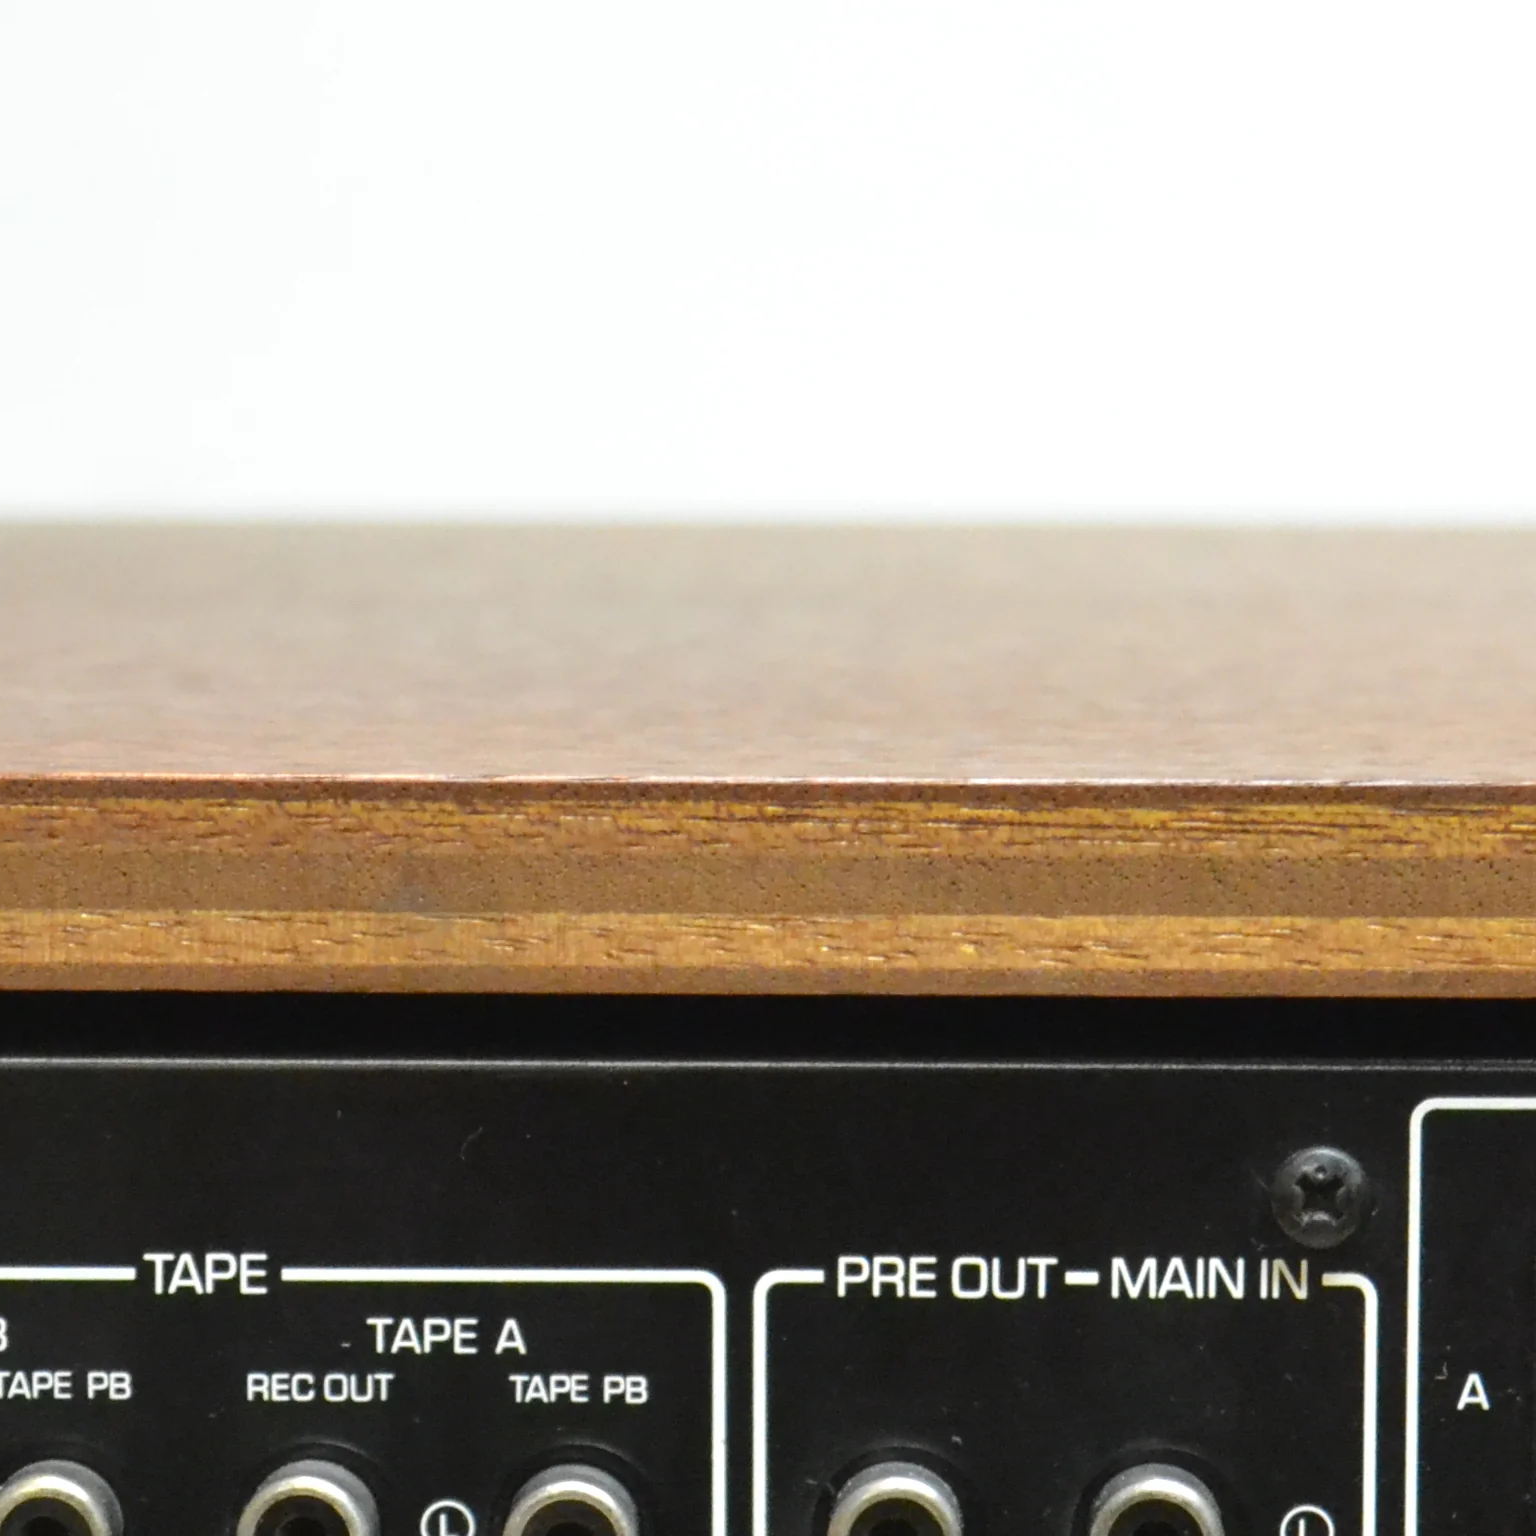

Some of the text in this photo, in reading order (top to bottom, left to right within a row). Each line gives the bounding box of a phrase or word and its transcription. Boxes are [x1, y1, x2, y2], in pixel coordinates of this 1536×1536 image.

[143, 1253, 269, 1296] TAPE
[838, 1256, 1060, 1301] PRE OUT
[1112, 1257, 1309, 1301] MAIN IN
[367, 1318, 528, 1356] TAPE A
[88, 1371, 133, 1401] PB
[247, 1373, 396, 1404] REC OUT
[509, 1374, 650, 1406] TAPE PB
[1457, 1373, 1491, 1412] A
